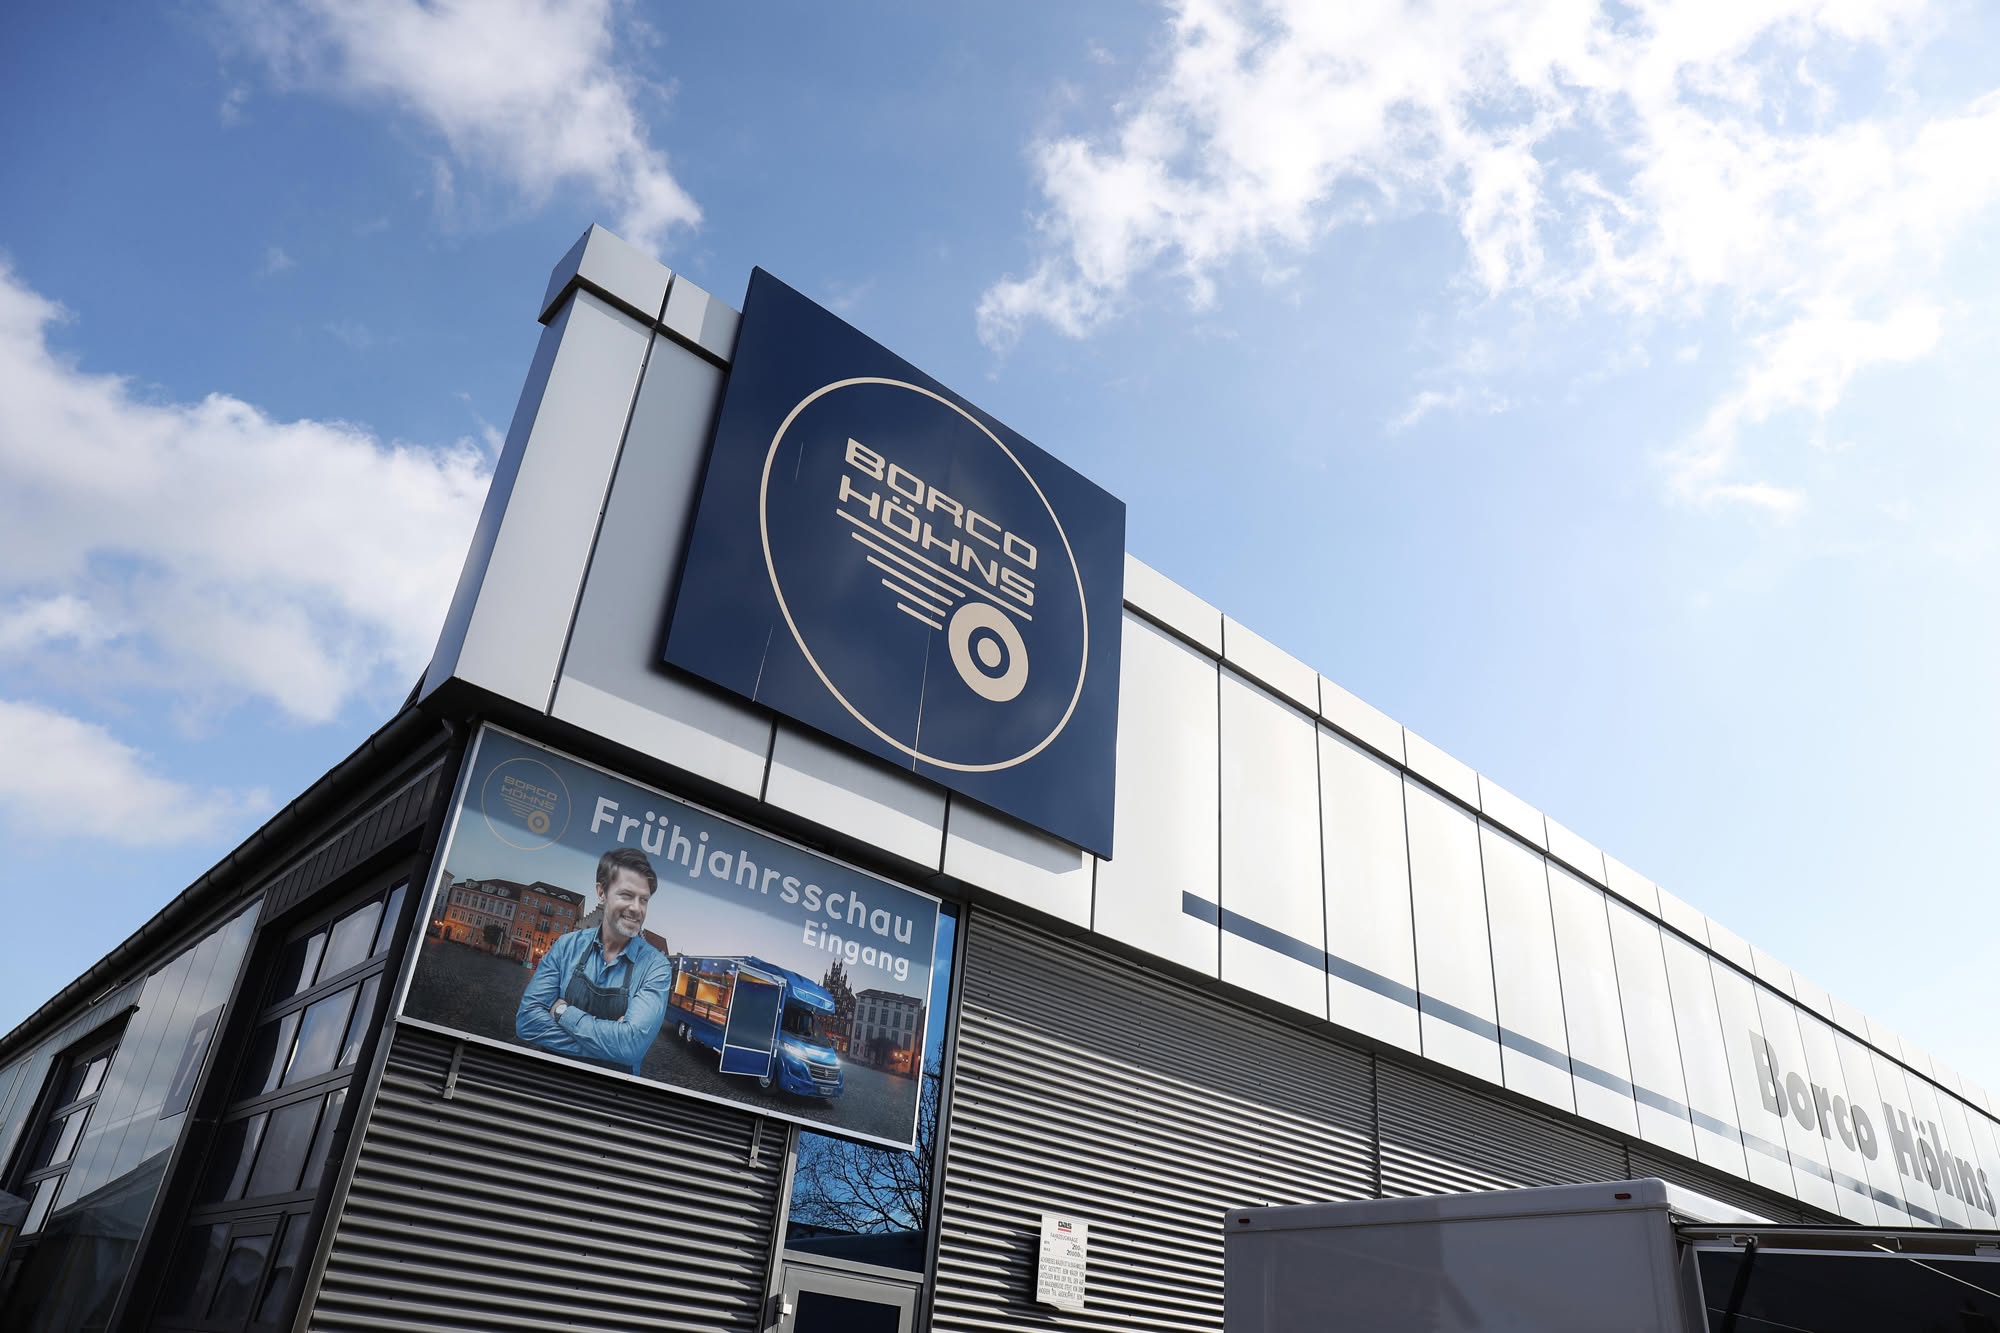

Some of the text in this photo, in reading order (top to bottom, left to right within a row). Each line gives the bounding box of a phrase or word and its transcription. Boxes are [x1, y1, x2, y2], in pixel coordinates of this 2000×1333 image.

[838, 474, 1035, 607] HÖHNS
[845, 437, 1037, 570] BORCO
[503, 775, 558, 801] BORCO
[590, 796, 913, 945] Frühjahrsschau
[802, 919, 909, 982] Eingang
[1749, 1029, 1998, 1218] Borco Höhns
